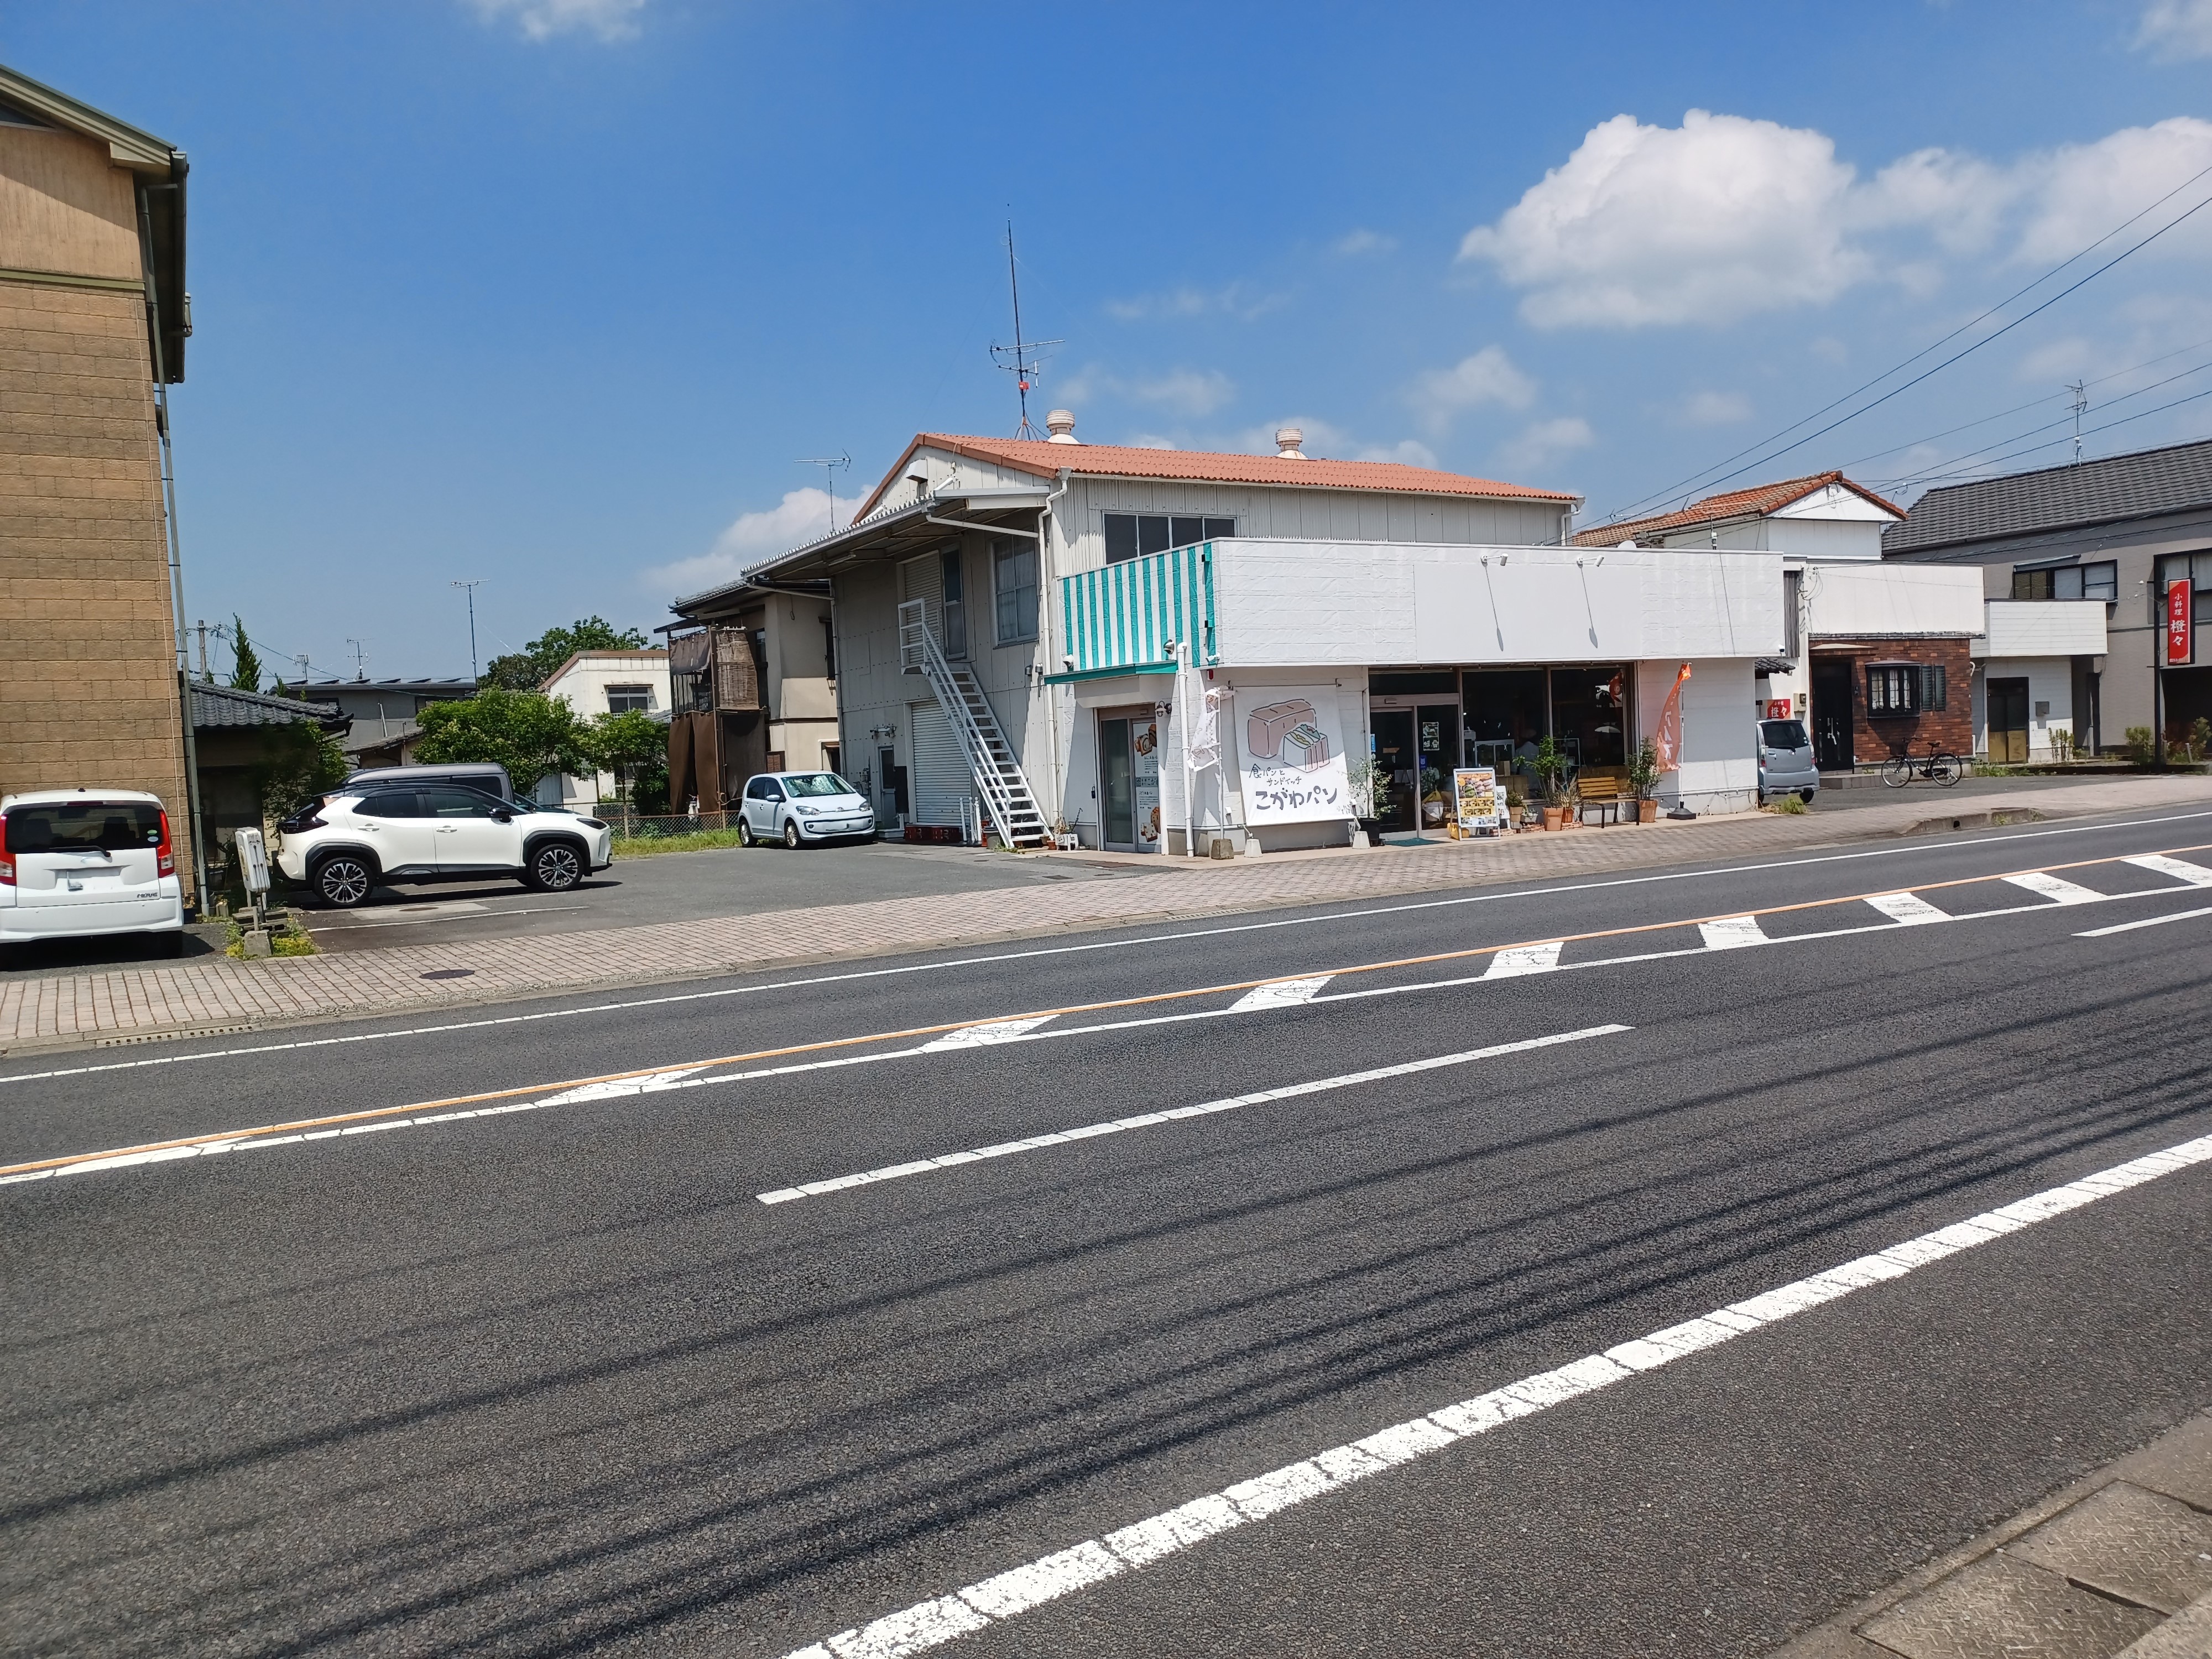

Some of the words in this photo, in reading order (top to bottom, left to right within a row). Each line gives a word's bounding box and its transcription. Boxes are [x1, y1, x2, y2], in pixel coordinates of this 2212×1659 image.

[2174, 593, 2183, 615] 小料理
[2170, 619, 2186, 646] 橙々
[1249, 763, 1285, 779] 食パンと
[1266, 776, 1302, 786] サンドイッチ
[1255, 785, 1337, 810] こがわパン
